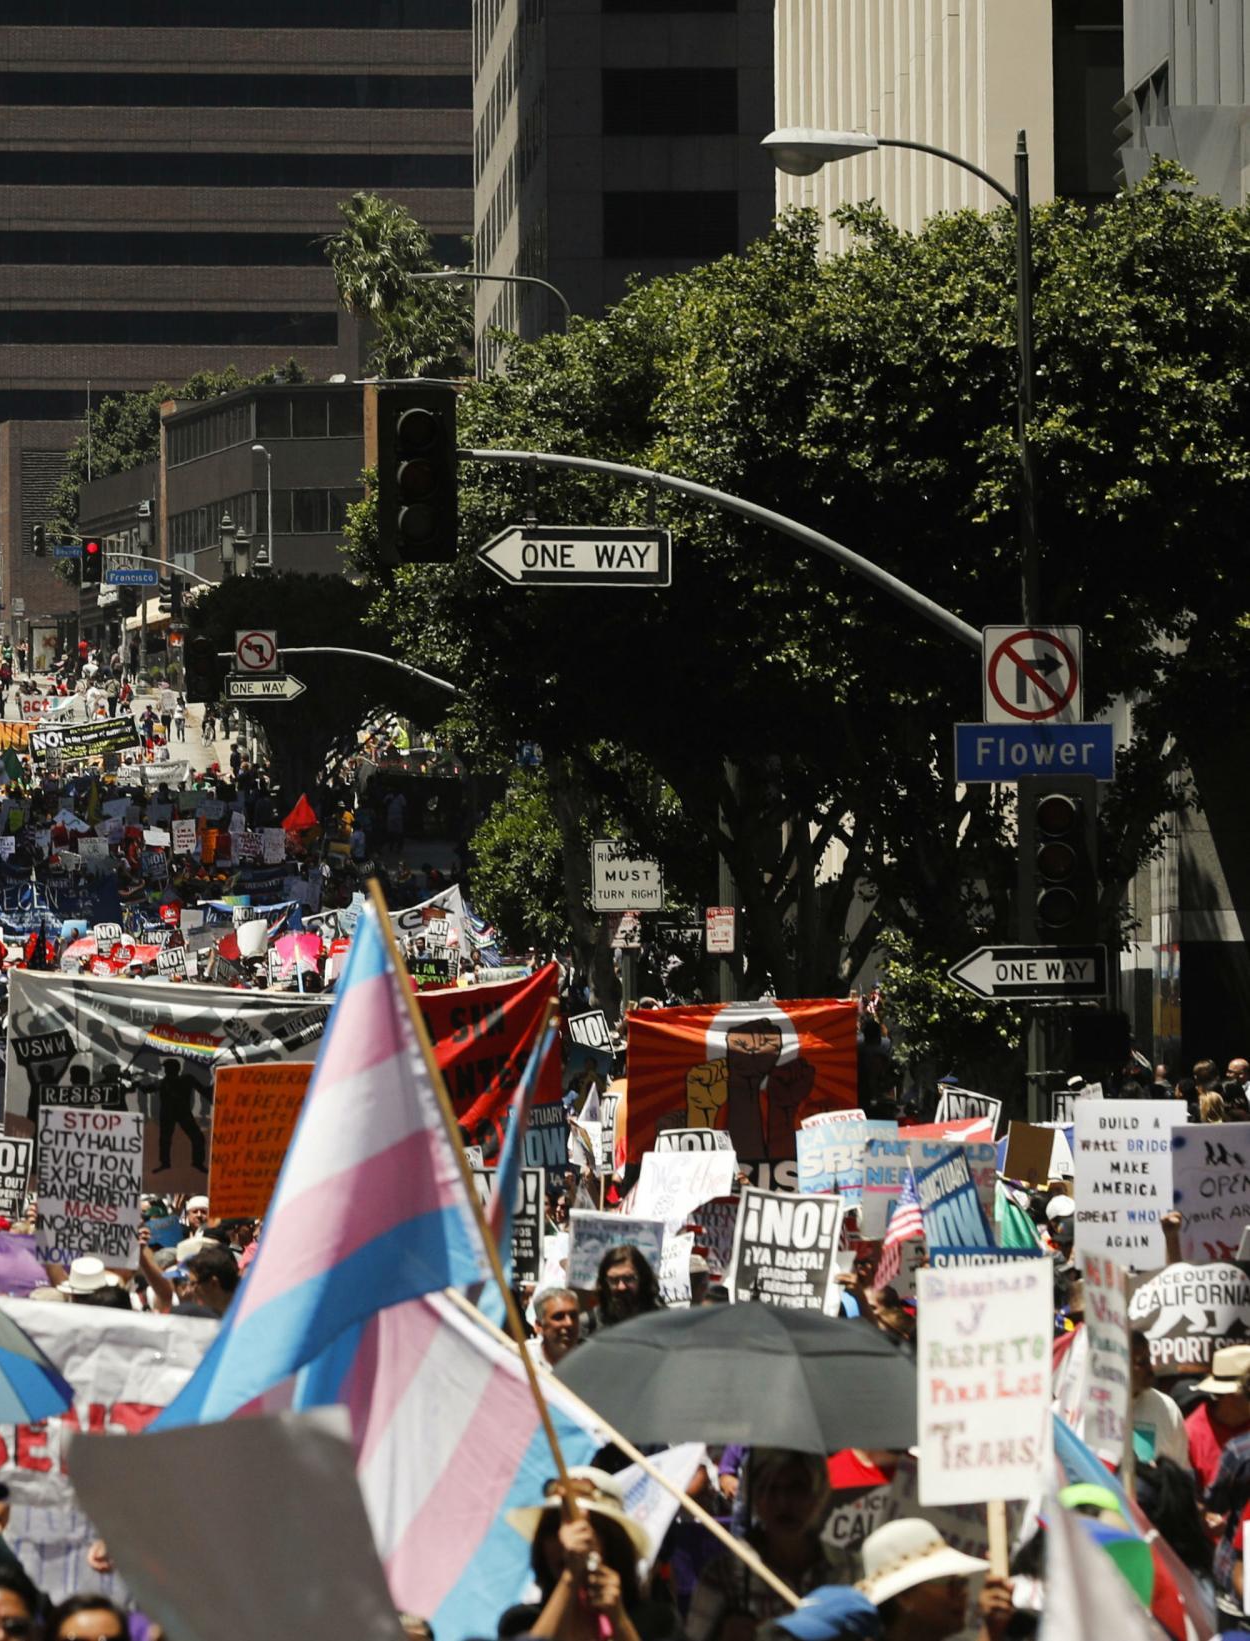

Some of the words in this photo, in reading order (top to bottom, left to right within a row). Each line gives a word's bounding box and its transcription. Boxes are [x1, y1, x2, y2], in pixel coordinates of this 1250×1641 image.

[521, 542, 576, 569] ONE
[595, 542, 652, 569] WAY
[109, 573, 154, 583] Francisco
[231, 682, 256, 695] ONE
[262, 682, 287, 695] WAY
[32, 731, 65, 750] NO!
[975, 736, 1095, 767] Flower
[605, 871, 650, 881] MUST
[599, 890, 624, 899] TURN
[631, 890, 659, 899] RIGHT
[997, 961, 1037, 983] ONE
[1044, 961, 1089, 983] WAY
[571, 1018, 610, 1045] NO!
[18, 1035, 68, 1058] USWW
[45, 1086, 113, 1104] RESIST
[64, 1112, 121, 1131] STOP
[528, 1106, 563, 1125] CTUARY
[1099, 1117, 1139, 1129] BUILD
[1153, 1118, 1160, 1129] A
[523, 1126, 567, 1167] OW
[1127, 1139, 1172, 1152] BRIDG
[38, 1147, 134, 1175] EVICTION
[1110, 1162, 1150, 1175] MAKE
[38, 1165, 142, 1193] EXPULSION
[917, 1153, 971, 1210] SANCTUARY
[1092, 1182, 1157, 1196] AMERICA
[1200, 1176, 1250, 1198] OPEN
[37, 1183, 142, 1210] BANISHMENT
[65, 1200, 119, 1224] MASS
[744, 1195, 836, 1250] ¡NO!
[924, 1188, 990, 1248] NOW
[1077, 1210, 1118, 1223] GREAT
[55, 1232, 130, 1258] REGIMEN
[1106, 1236, 1150, 1248] AGAIN
[775, 1249, 826, 1271] BASTA!
[1157, 1271, 1181, 1286] ICE
[1184, 1270, 1214, 1283] OUT
[1218, 1269, 1238, 1282] OF
[1136, 1283, 1250, 1311] CALIFORNIA
[1149, 1336, 1213, 1366] PPORT
